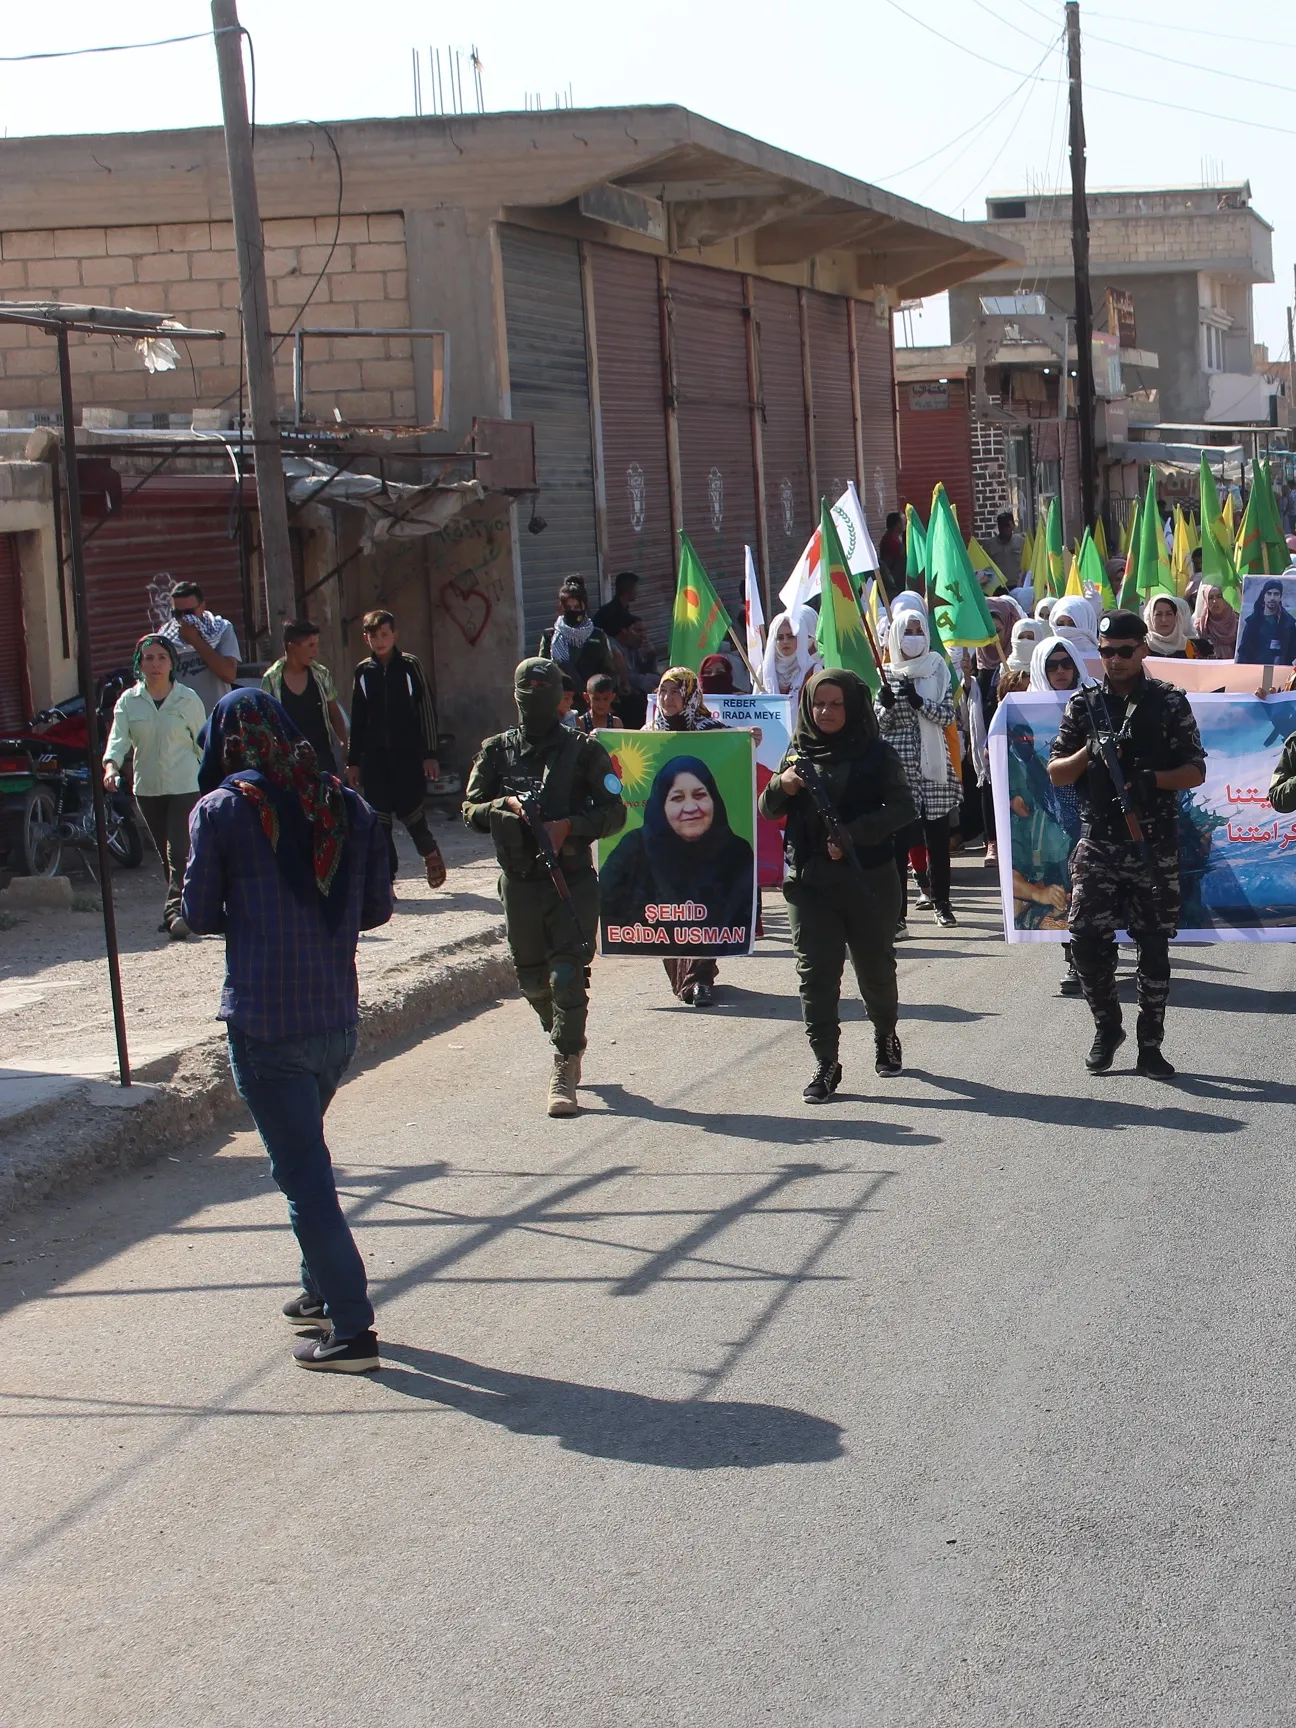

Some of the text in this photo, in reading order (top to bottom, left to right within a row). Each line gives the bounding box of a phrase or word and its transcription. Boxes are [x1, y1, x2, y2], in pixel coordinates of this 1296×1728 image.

[722, 711, 752, 719] IRADA
[754, 711, 781, 719] MEYE
[1226, 784, 1272, 808] يتنا
[645, 900, 707, 923] ŞEHÎD
[608, 923, 745, 943] EQÎDA USMAN
